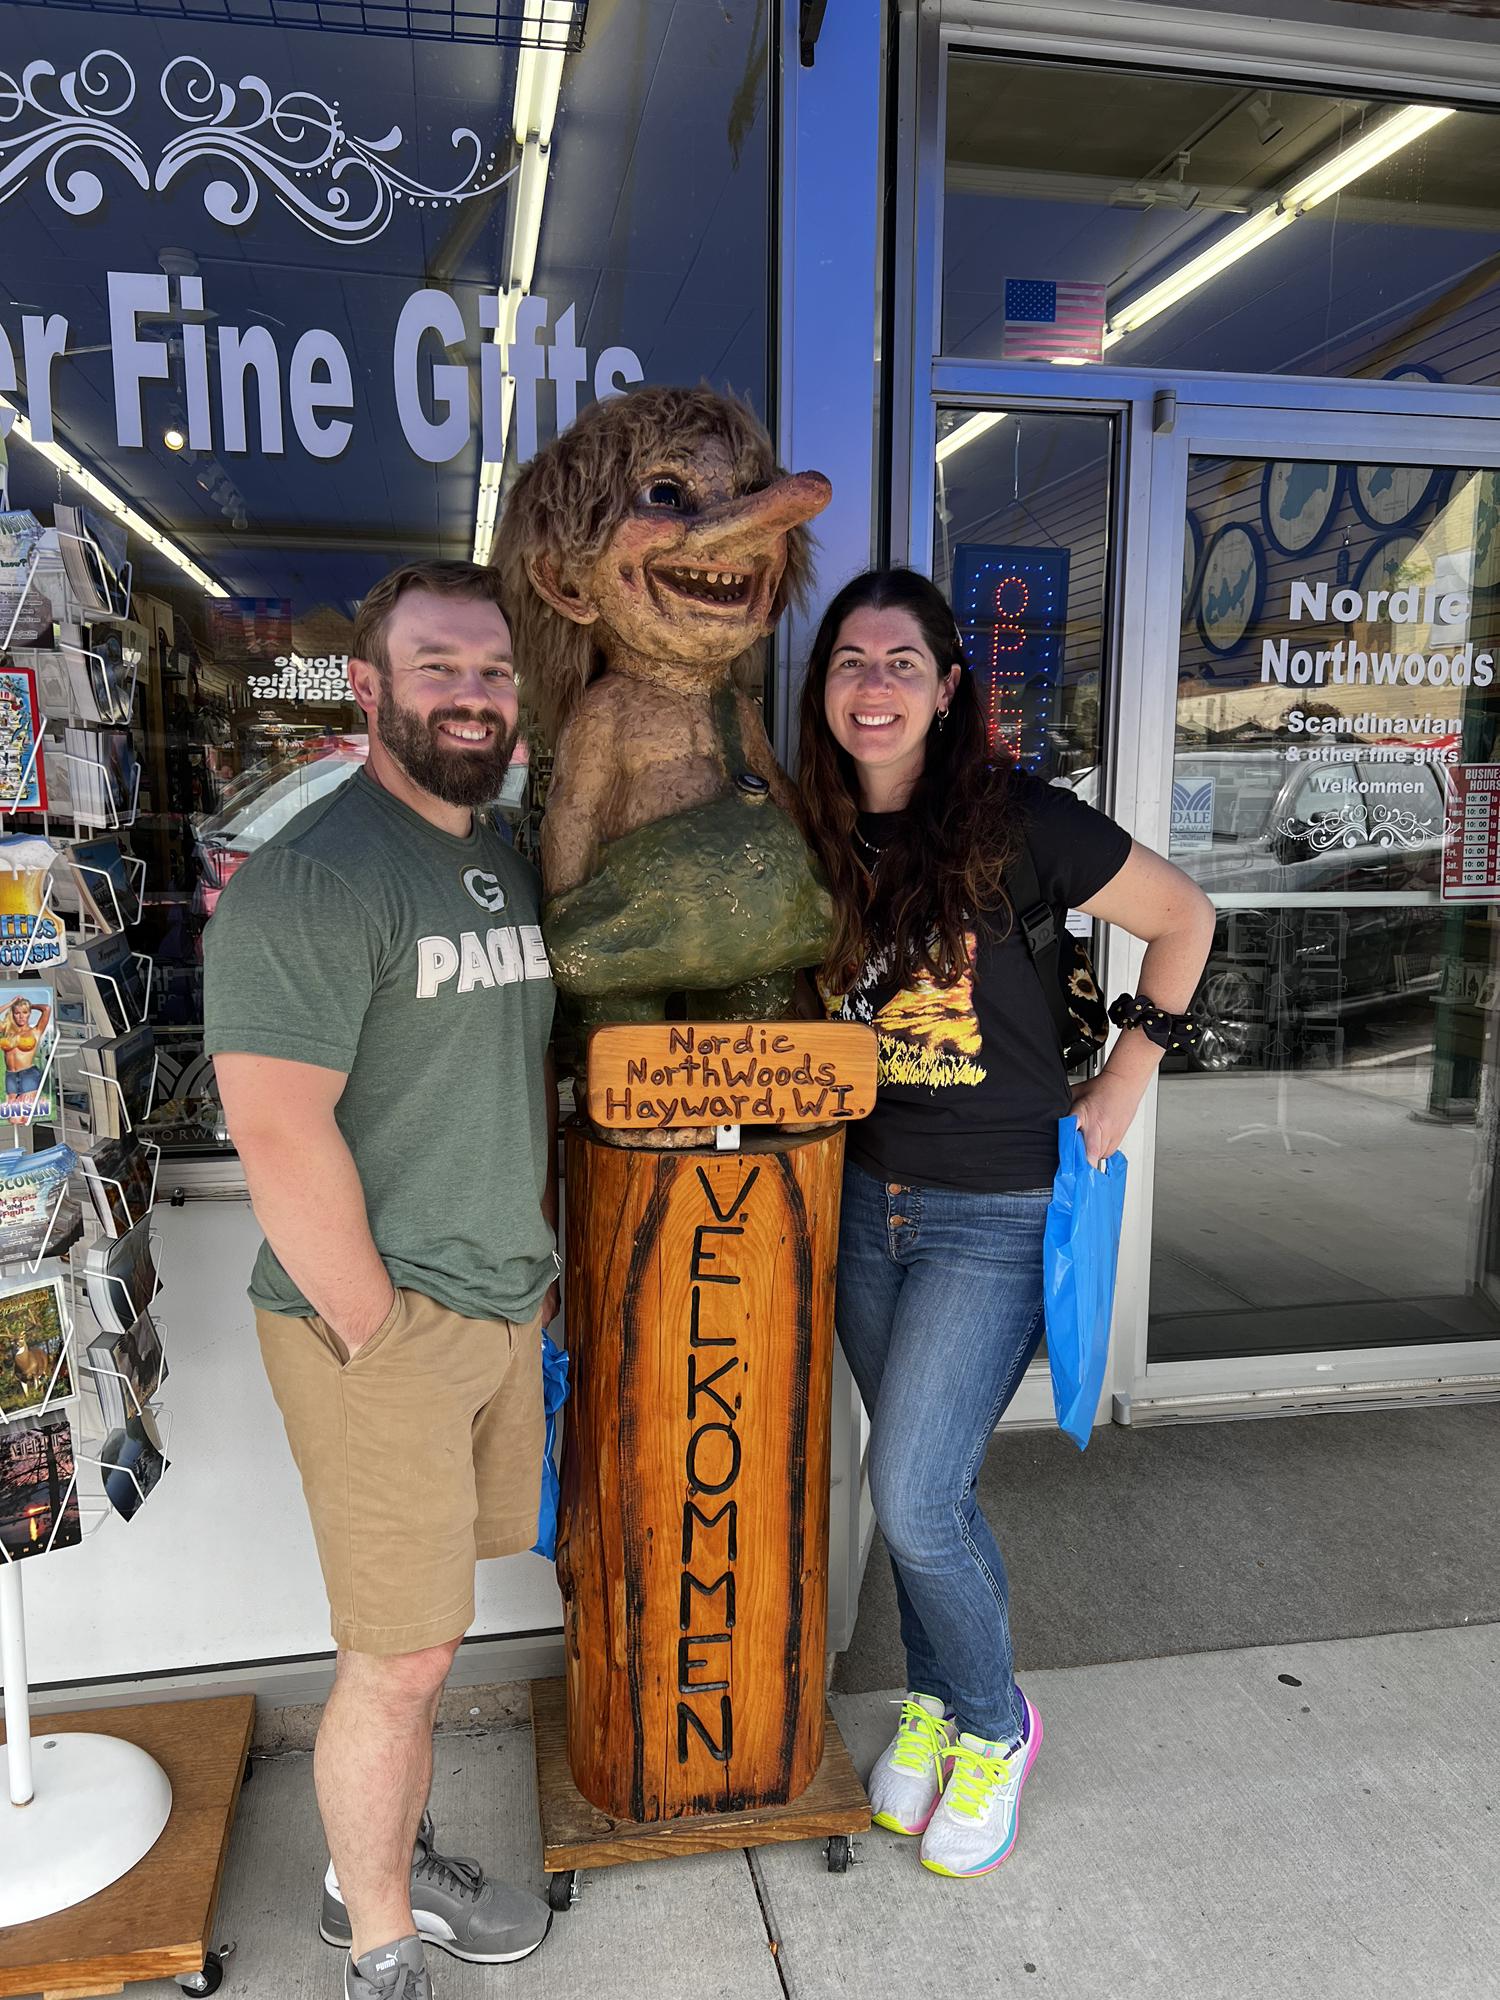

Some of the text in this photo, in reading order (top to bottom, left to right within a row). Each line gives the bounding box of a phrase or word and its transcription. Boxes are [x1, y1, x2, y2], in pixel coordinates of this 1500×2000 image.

[0, 313, 68, 443] r
[107, 271, 355, 459] Fine
[1289, 581, 1471, 625] Nordic
[989, 575, 1029, 760] OPEN
[1261, 638, 1494, 687] Northwoods
[1287, 710, 1462, 735] Scandinavian
[1285, 747, 1459, 767] & other fine gifts
[1465, 768, 1500, 780] BUSINE
[1317, 778, 1425, 794] Velkommen
[1172, 812, 1210, 824] DALE
[462, 866, 508, 915] G
[670, 1025, 795, 1054] Nordic
[628, 1053, 836, 1088] NorthWoods
[606, 1084, 866, 1127] Hayward, WI.
[677, 1165, 761, 1765] VELKOMMEN
[375, 1958, 396, 1972] PUMA
